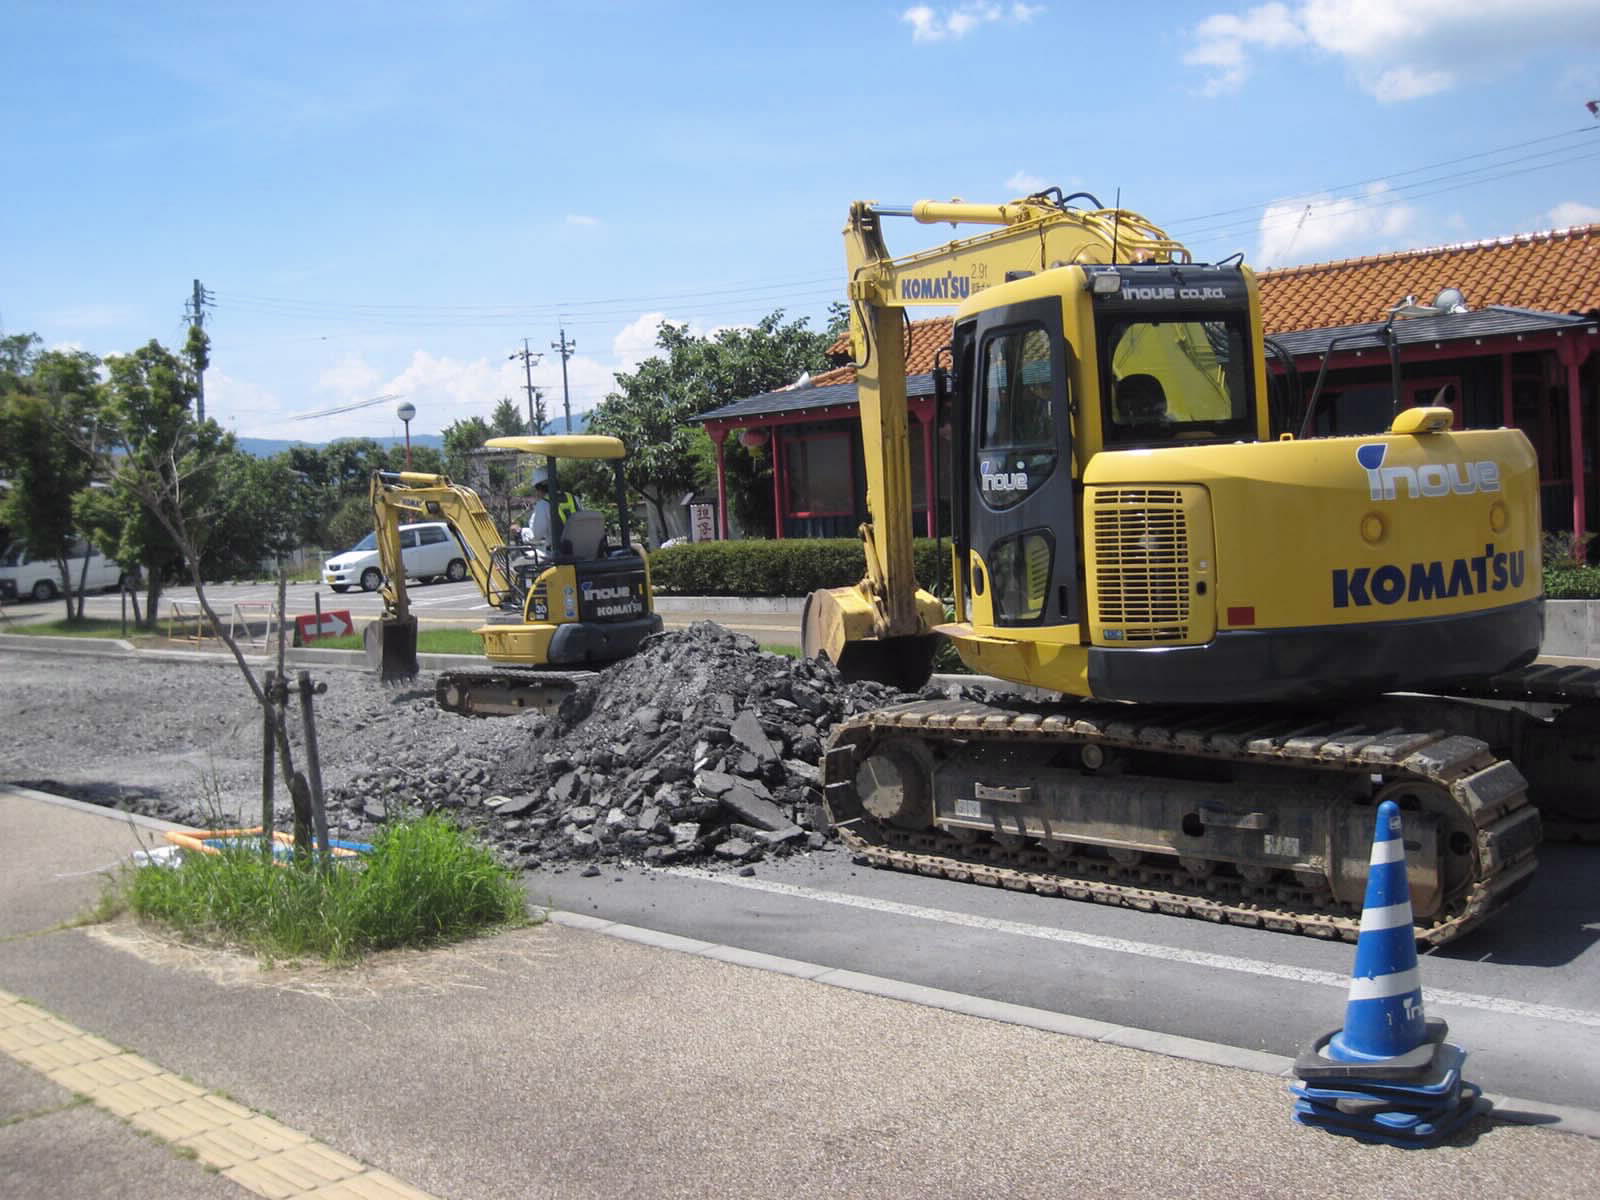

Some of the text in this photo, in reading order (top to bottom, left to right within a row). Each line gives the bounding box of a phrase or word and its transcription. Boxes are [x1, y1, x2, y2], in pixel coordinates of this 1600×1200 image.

[902, 270, 970, 299] KOMATSU
[1356, 443, 1501, 501] inoue
[1332, 543, 1525, 608] KOMATSU
[597, 596, 643, 616] KOMATSU
